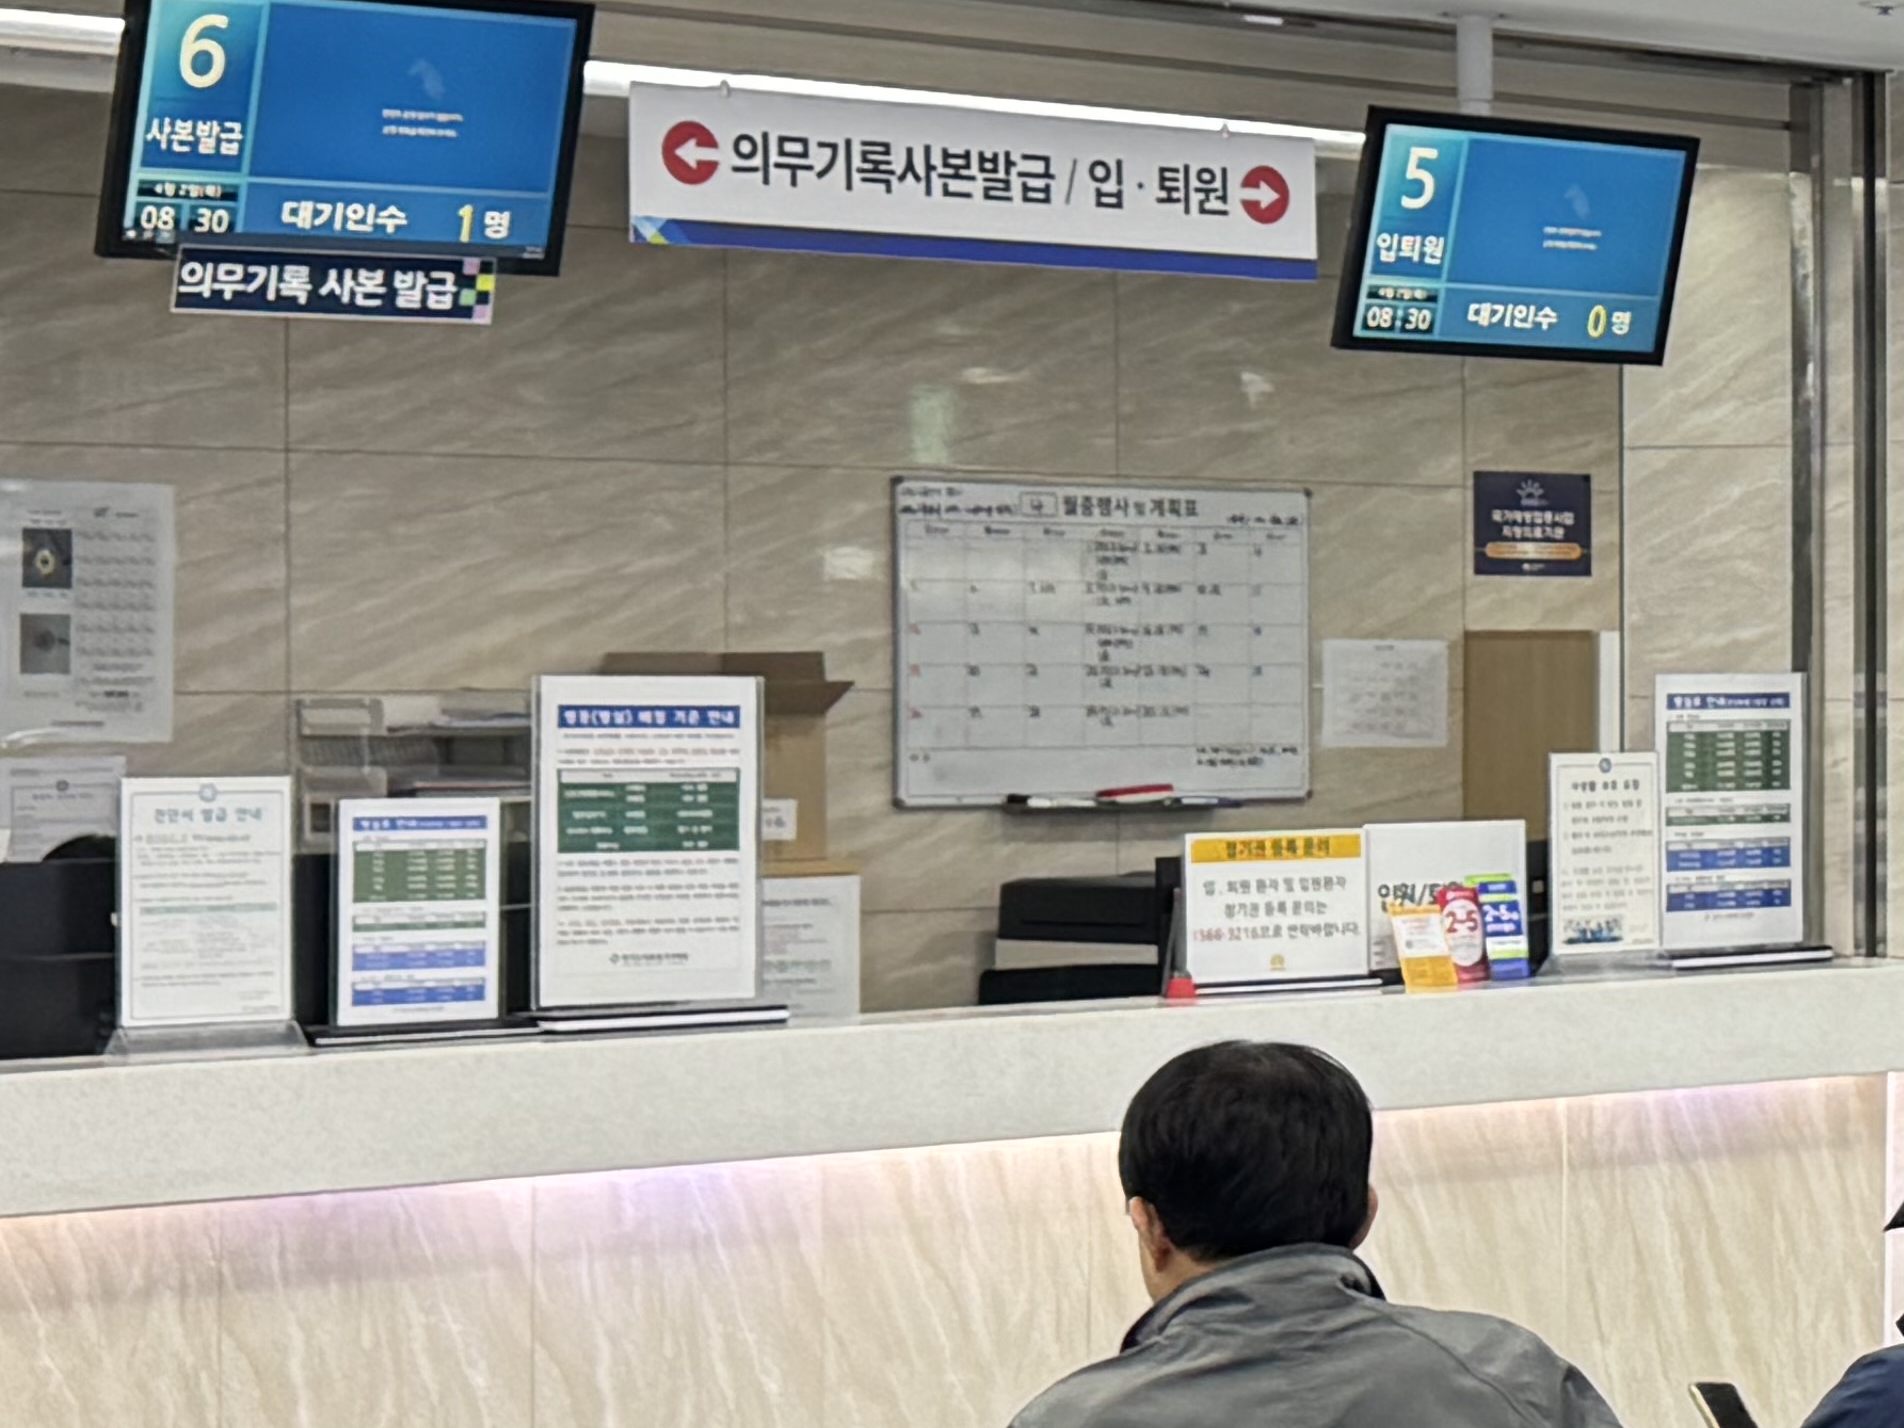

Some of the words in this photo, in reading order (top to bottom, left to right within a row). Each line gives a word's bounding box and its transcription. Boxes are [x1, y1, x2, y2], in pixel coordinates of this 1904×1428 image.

[179, 13, 229, 88] 6
[146, 117, 243, 155] 사본발급
[731, 130, 1055, 205] 의무기록사본발급
[1401, 146, 1439, 210] 5
[140, 205, 176, 231] 08
[194, 208, 230, 233] 30
[281, 200, 408, 234] 대기인수
[458, 204, 474, 243] 1
[484, 210, 511, 238] 명
[1377, 232, 1445, 265] 입퇴원
[178, 261, 312, 305] 의무기록
[319, 267, 386, 307] 사본
[393, 270, 457, 310] 발급
[1467, 302, 1559, 331] 대기인수
[1587, 304, 1607, 338] 0
[1611, 311, 1632, 335] 명
[1063, 495, 1130, 518] 월중행사
[1150, 497, 1198, 517] 계획표
